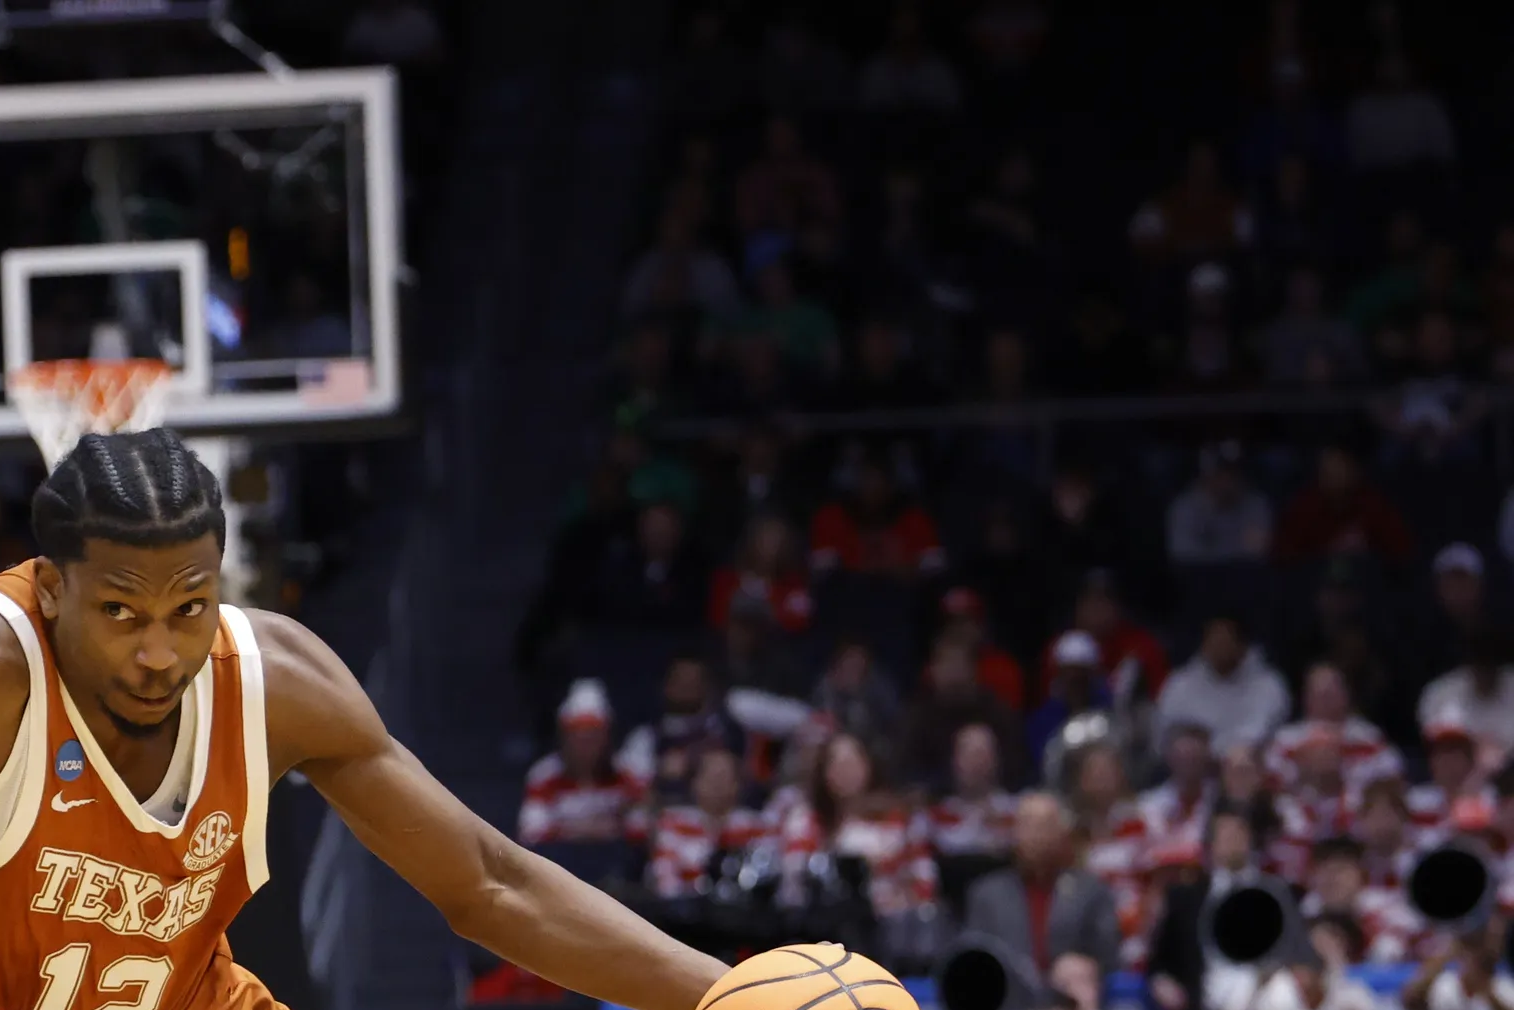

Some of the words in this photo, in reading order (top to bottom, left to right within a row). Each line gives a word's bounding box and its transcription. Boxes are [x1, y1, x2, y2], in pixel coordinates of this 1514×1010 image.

[58, 760, 83, 771] NCAA
[192, 814, 228, 857] SEC
[186, 842, 231, 871] GRADUATE
[30, 846, 225, 942] TEXAS
